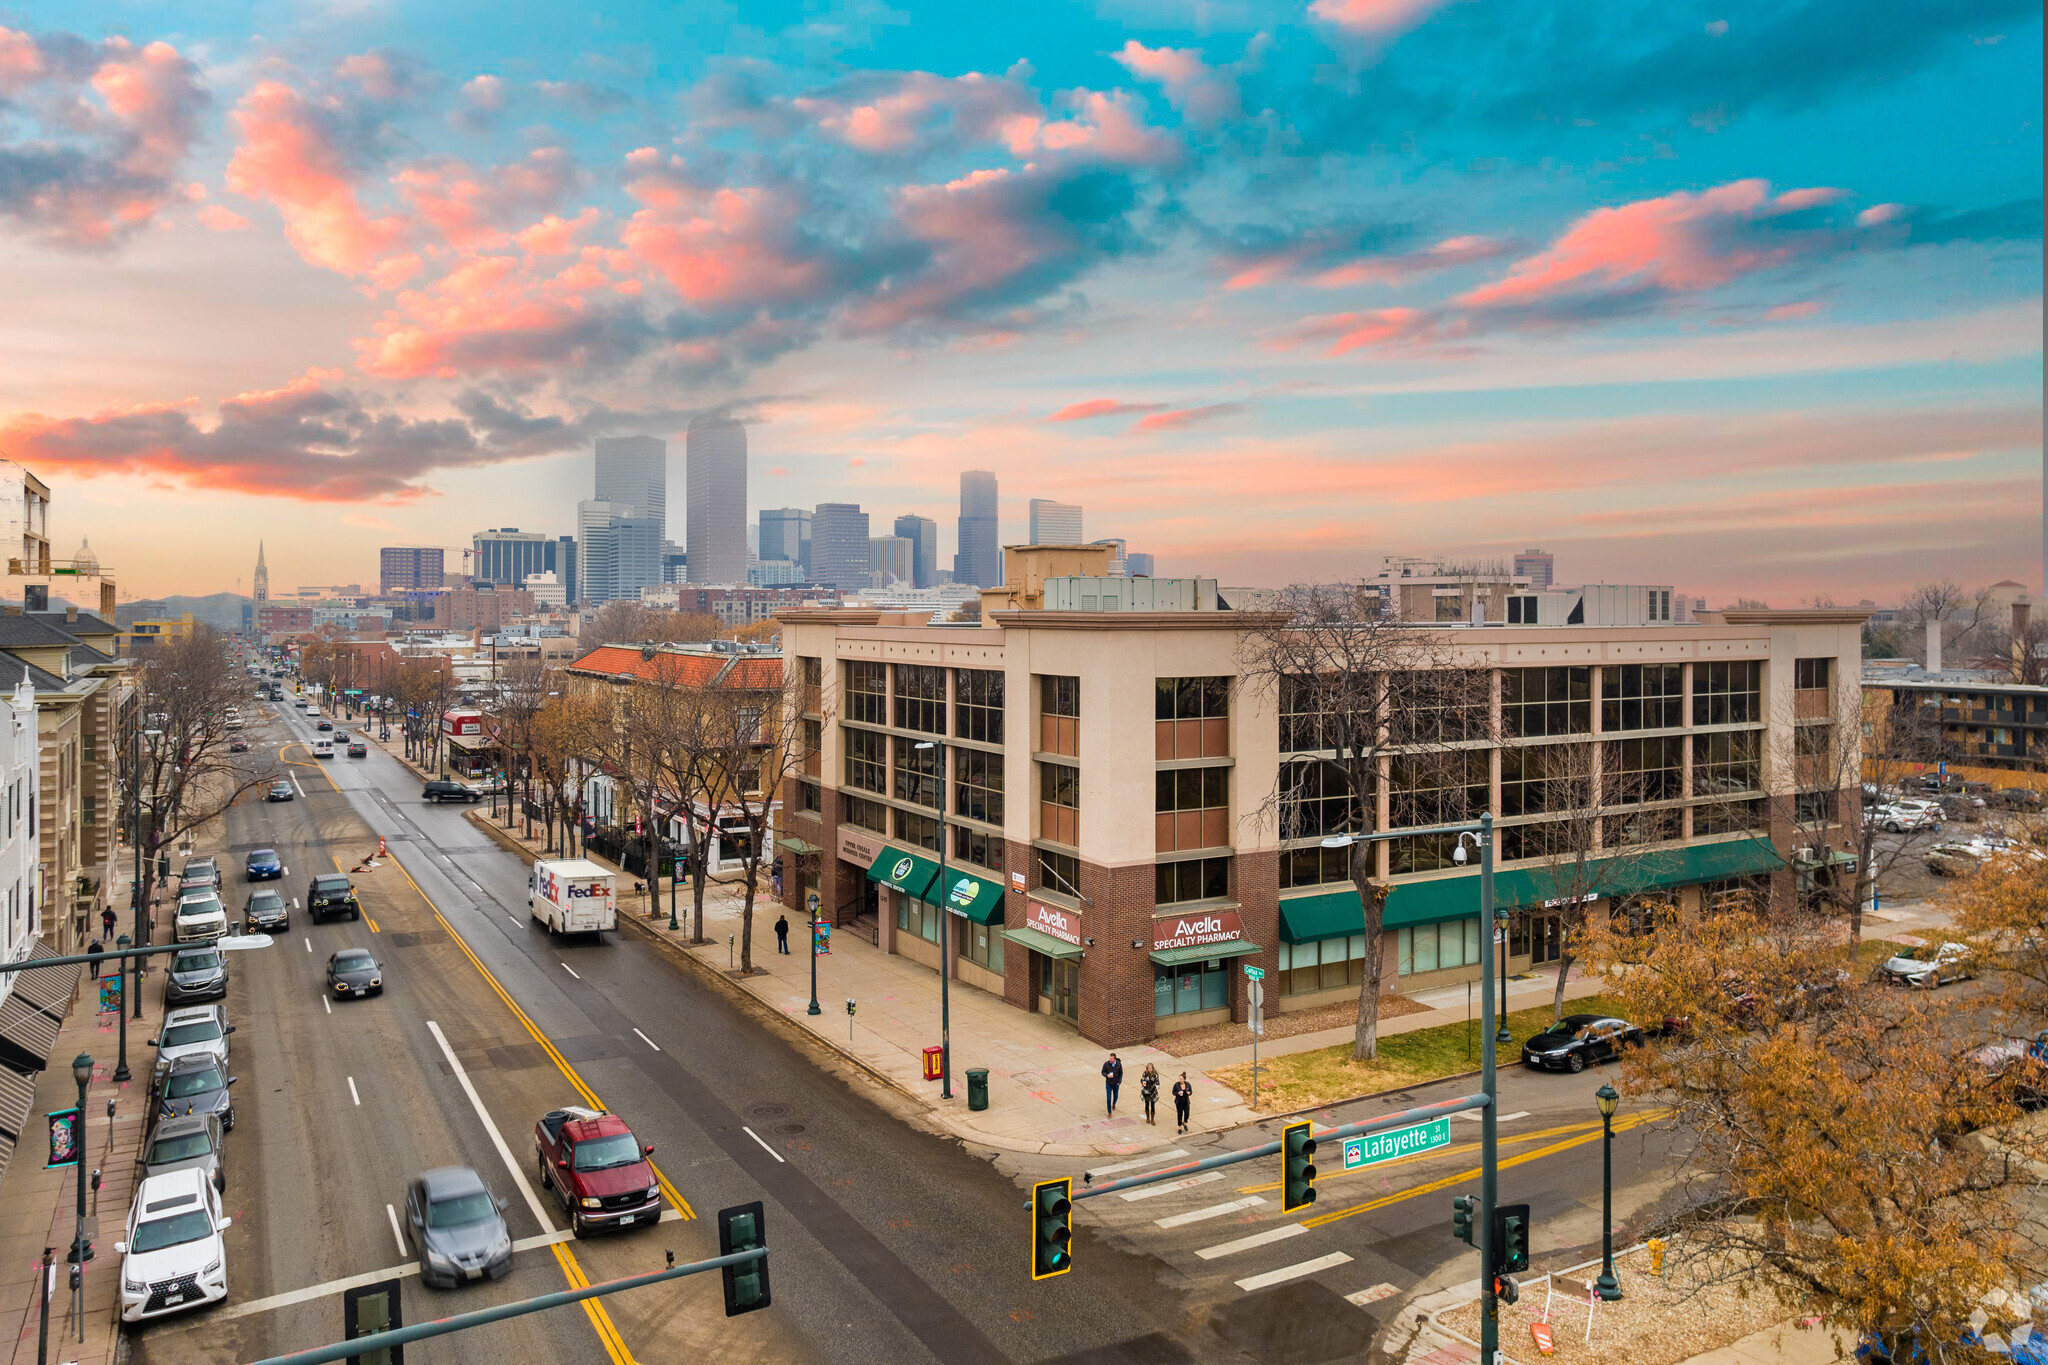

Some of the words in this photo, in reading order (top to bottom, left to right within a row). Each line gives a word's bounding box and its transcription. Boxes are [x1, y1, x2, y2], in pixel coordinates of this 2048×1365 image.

[539, 866, 559, 905] FedEx
[568, 883, 611, 898] FedEx
[1038, 906, 1067, 931] Avella
[1175, 917, 1221, 937] Avella
[1026, 918, 1051, 934] SPECIALTY
[1051, 928, 1080, 945] PHARMACY
[1154, 935, 1196, 950] SPECIALTY
[1197, 930, 1241, 944] PHARMACY
[1430, 1134, 1441, 1144] 1300
[1442, 1132, 1446, 1140] E
[1435, 1125, 1440, 1133] St
[1364, 1129, 1427, 1158] Lafayette
